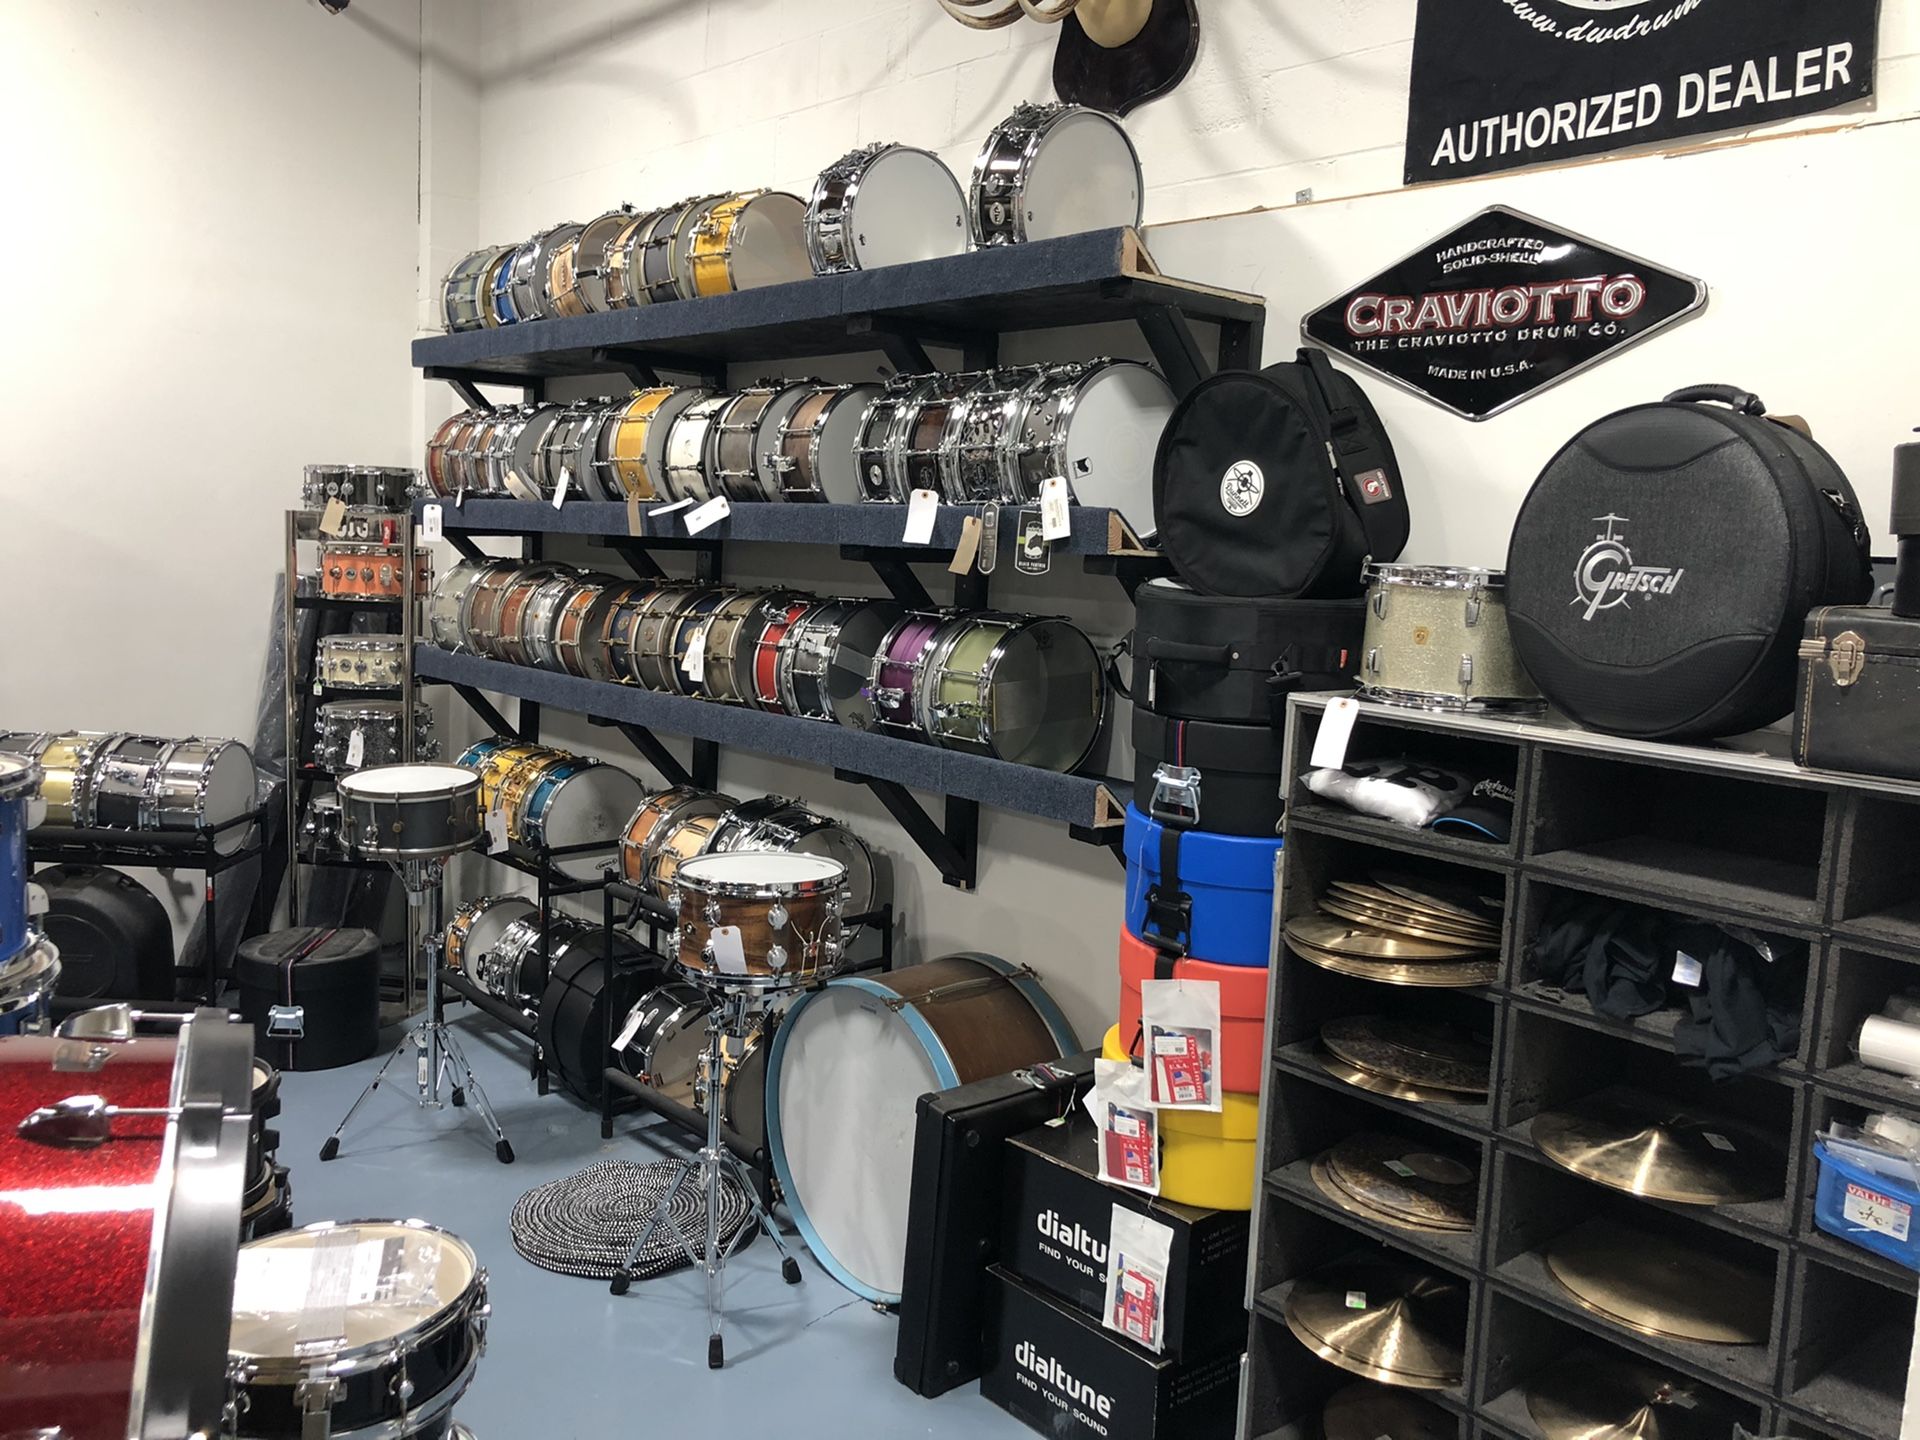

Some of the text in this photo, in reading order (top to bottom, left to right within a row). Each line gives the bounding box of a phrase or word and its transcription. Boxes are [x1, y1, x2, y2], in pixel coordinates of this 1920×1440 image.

[1431, 41, 1854, 166] AUTHORIZED DEALER
[1436, 237, 1545, 263] HANDCRAFTED
[1346, 276, 1645, 335] CRAVIOTTO
[1354, 321, 1626, 351] THE CRAVIOTTO DRUM CO.
[1427, 360, 1534, 380] MADE IN U.S.A.
[1037, 1208, 1107, 1264] dialtu
[1038, 1242, 1094, 1277] FIND YOUR
[1015, 1340, 1111, 1419] dialtune
[1016, 1372, 1108, 1436] FIND YOUR SOUND
